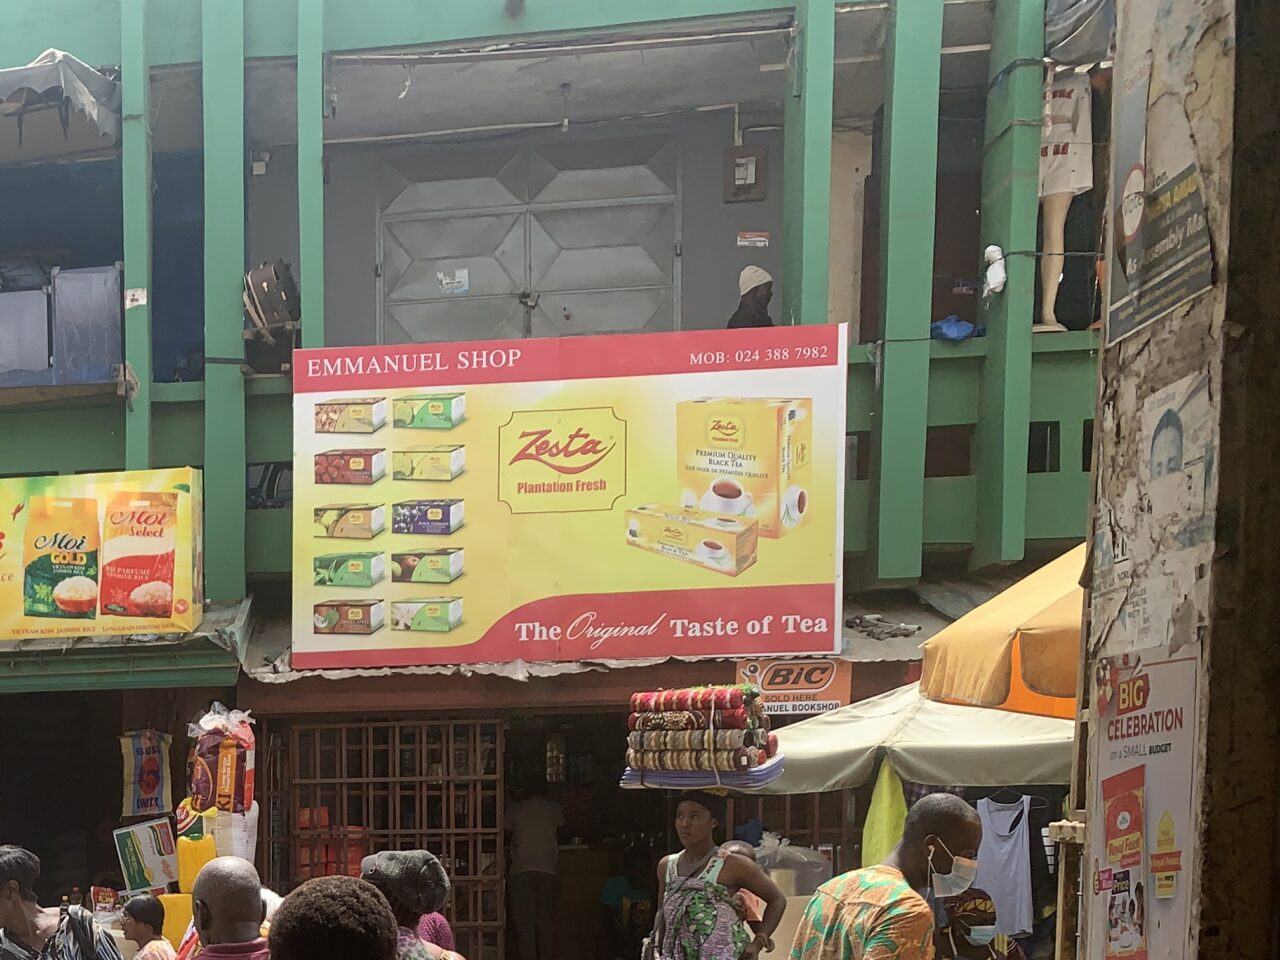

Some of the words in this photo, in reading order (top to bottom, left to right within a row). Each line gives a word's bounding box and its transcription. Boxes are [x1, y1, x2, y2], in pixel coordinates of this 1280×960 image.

[307, 352, 449, 377] EMMANUEL
[457, 349, 521, 369] SHOP
[690, 351, 730, 365] MOB:
[735, 350, 760, 363] 024
[765, 348, 790, 361] 388
[795, 346, 828, 359] 7982
[508, 427, 613, 470] Zesta
[517, 481, 573, 494] Plantation
[576, 479, 607, 492] Fresh
[34, 532, 87, 550] Moi
[128, 526, 165, 538] Select
[50, 552, 87, 564] GOLD
[515, 622, 561, 641] The
[566, 611, 667, 649] Original
[670, 618, 741, 637] Taste
[746, 616, 774, 634] of
[781, 615, 828, 633] Tea
[765, 694, 790, 703] SOLD
[792, 693, 818, 702] HERE
[1120, 679, 1144, 710] BIG
[792, 702, 840, 712] BOOKSHOP
[1107, 707, 1184, 741] CELEBRATION
[1123, 745, 1147, 758] SMALL
[1149, 743, 1172, 755] BUDGET
